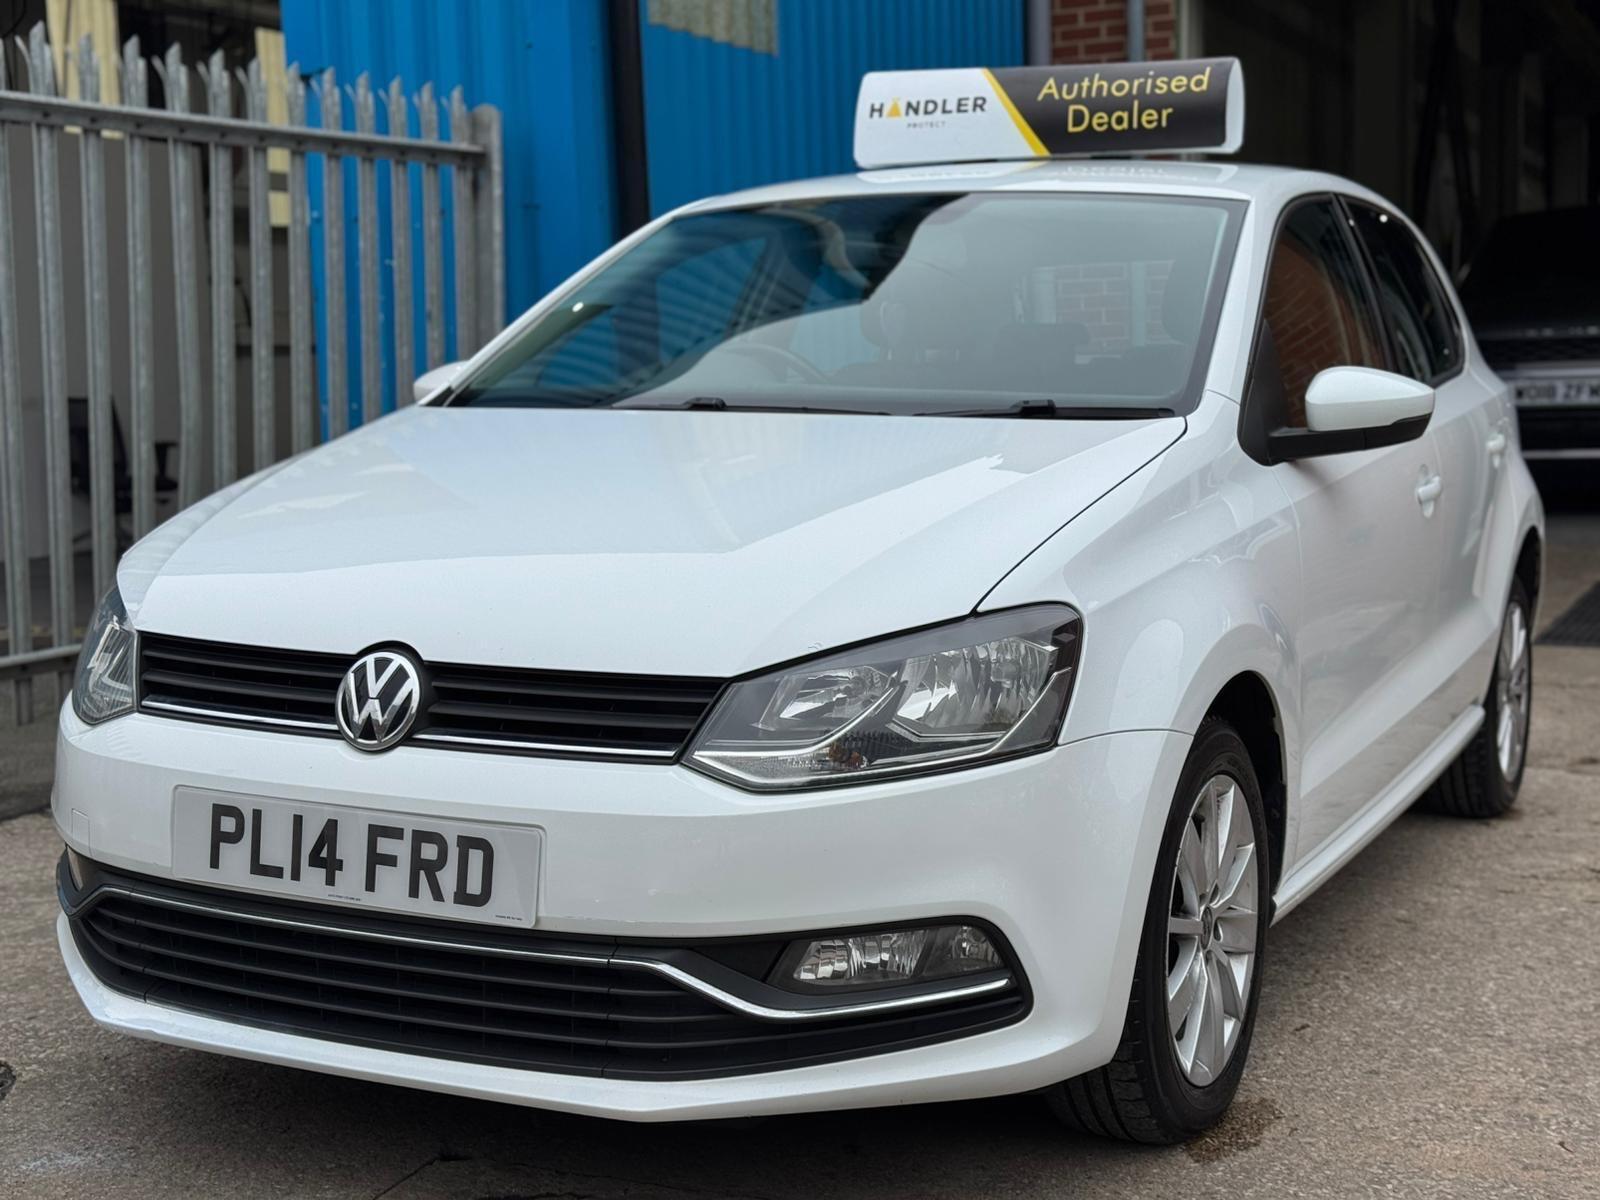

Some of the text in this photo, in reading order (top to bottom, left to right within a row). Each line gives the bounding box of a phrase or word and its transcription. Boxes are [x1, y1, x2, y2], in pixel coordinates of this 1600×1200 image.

[1037, 66, 1212, 101] Authorised
[1067, 99, 1174, 133] Dealer
[209, 803, 495, 908] PL14 FRD
